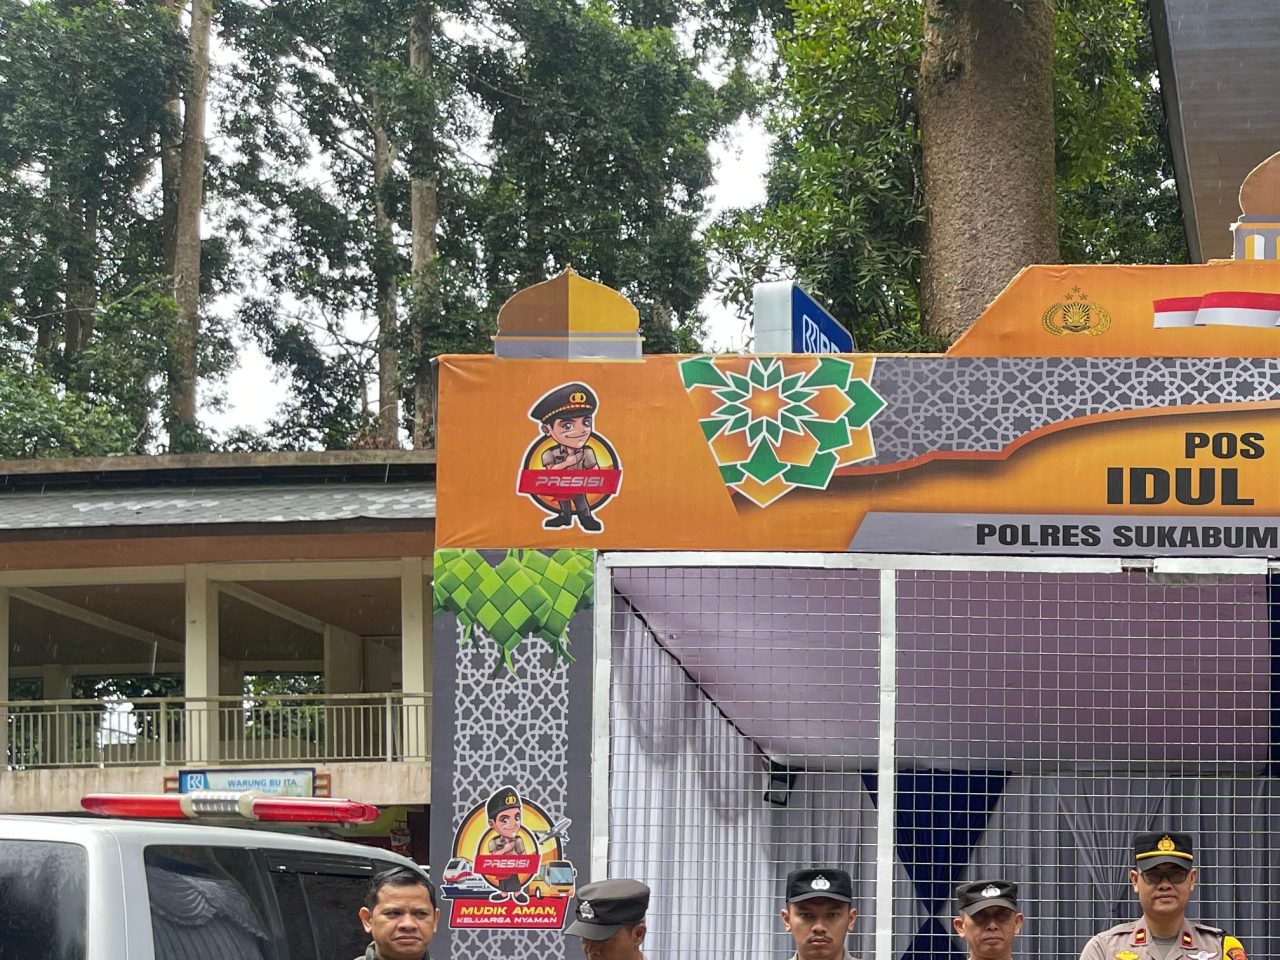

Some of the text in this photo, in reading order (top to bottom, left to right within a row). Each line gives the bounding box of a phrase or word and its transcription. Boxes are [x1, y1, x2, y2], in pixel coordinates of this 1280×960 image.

[1185, 432, 1265, 460] POS
[536, 476, 604, 487] PRESISI
[1107, 467, 1255, 506] IDUL
[976, 523, 1101, 547] POLRES
[227, 778, 297, 788] WARUNG BU ITA
[483, 859, 530, 869] PRESISI
[461, 906, 557, 917] MUDIK AMAN,
